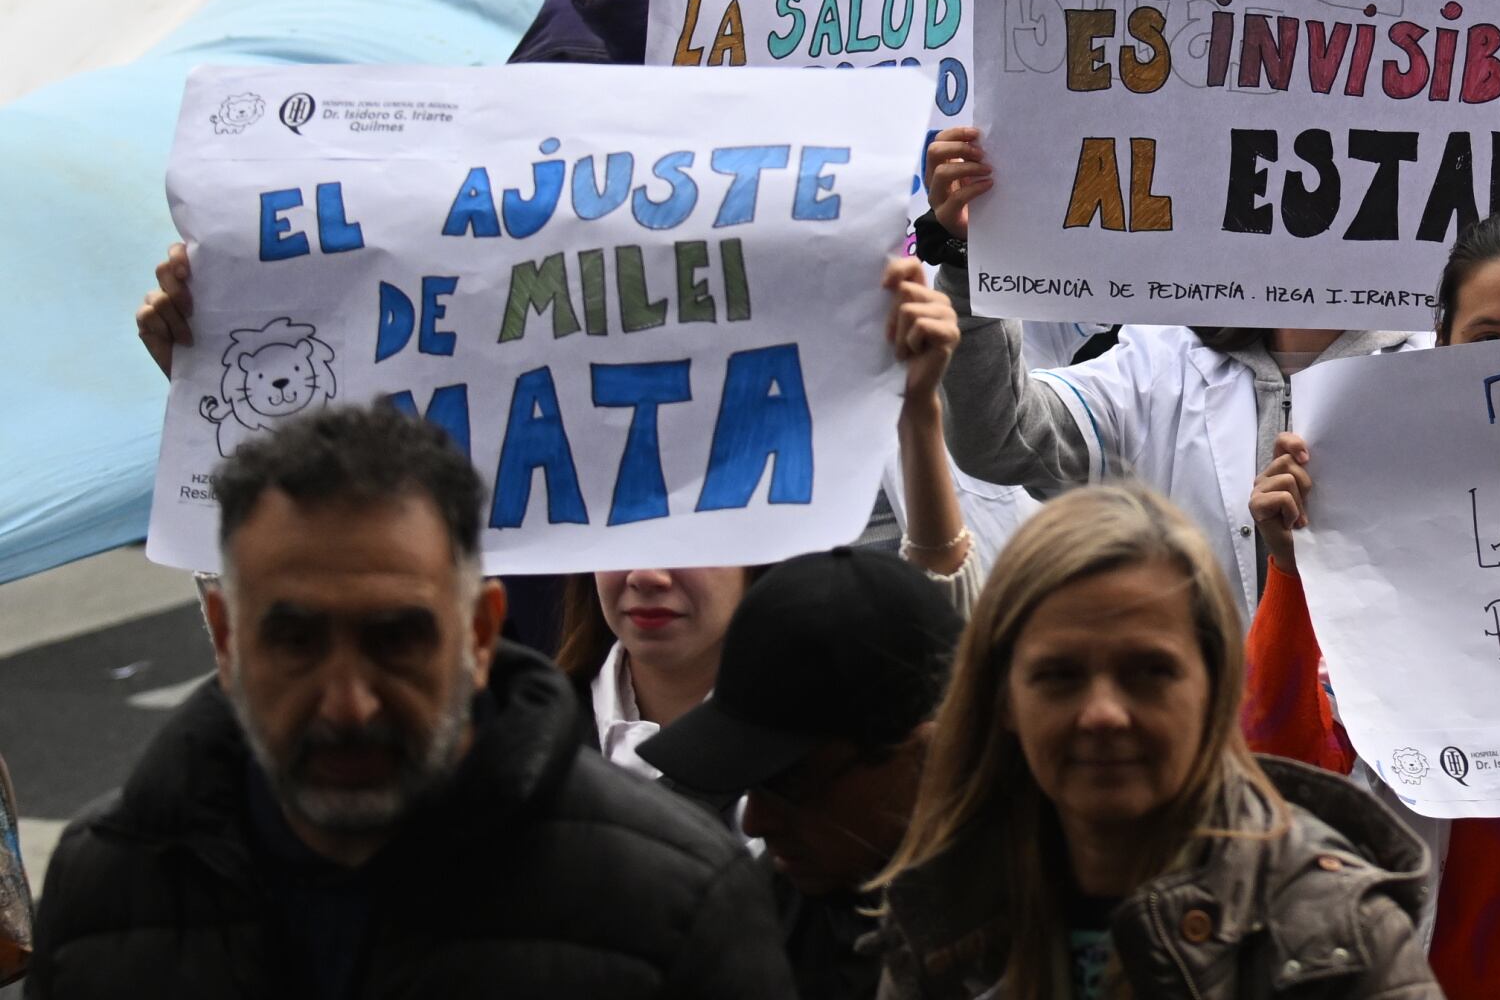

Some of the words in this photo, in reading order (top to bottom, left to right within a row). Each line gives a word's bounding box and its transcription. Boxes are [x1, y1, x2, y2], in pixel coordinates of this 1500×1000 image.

[1064, 6, 1171, 94] ES
[323, 108, 340, 119] Dr.
[344, 108, 390, 120] Isidoro
[394, 109, 407, 120] G.
[412, 110, 453, 122] Iriarte
[350, 120, 404, 132] Quilmes
[1063, 137, 1173, 233] AL
[259, 182, 365, 262] EL
[375, 275, 460, 364] DE
[498, 237, 752, 344] MILEI
[1109, 280, 1135, 298] DE
[1266, 285, 1315, 304] HZGA
[1471, 750, 1498, 758] HOSPITAL
[1475, 760, 1491, 770] Dr.
